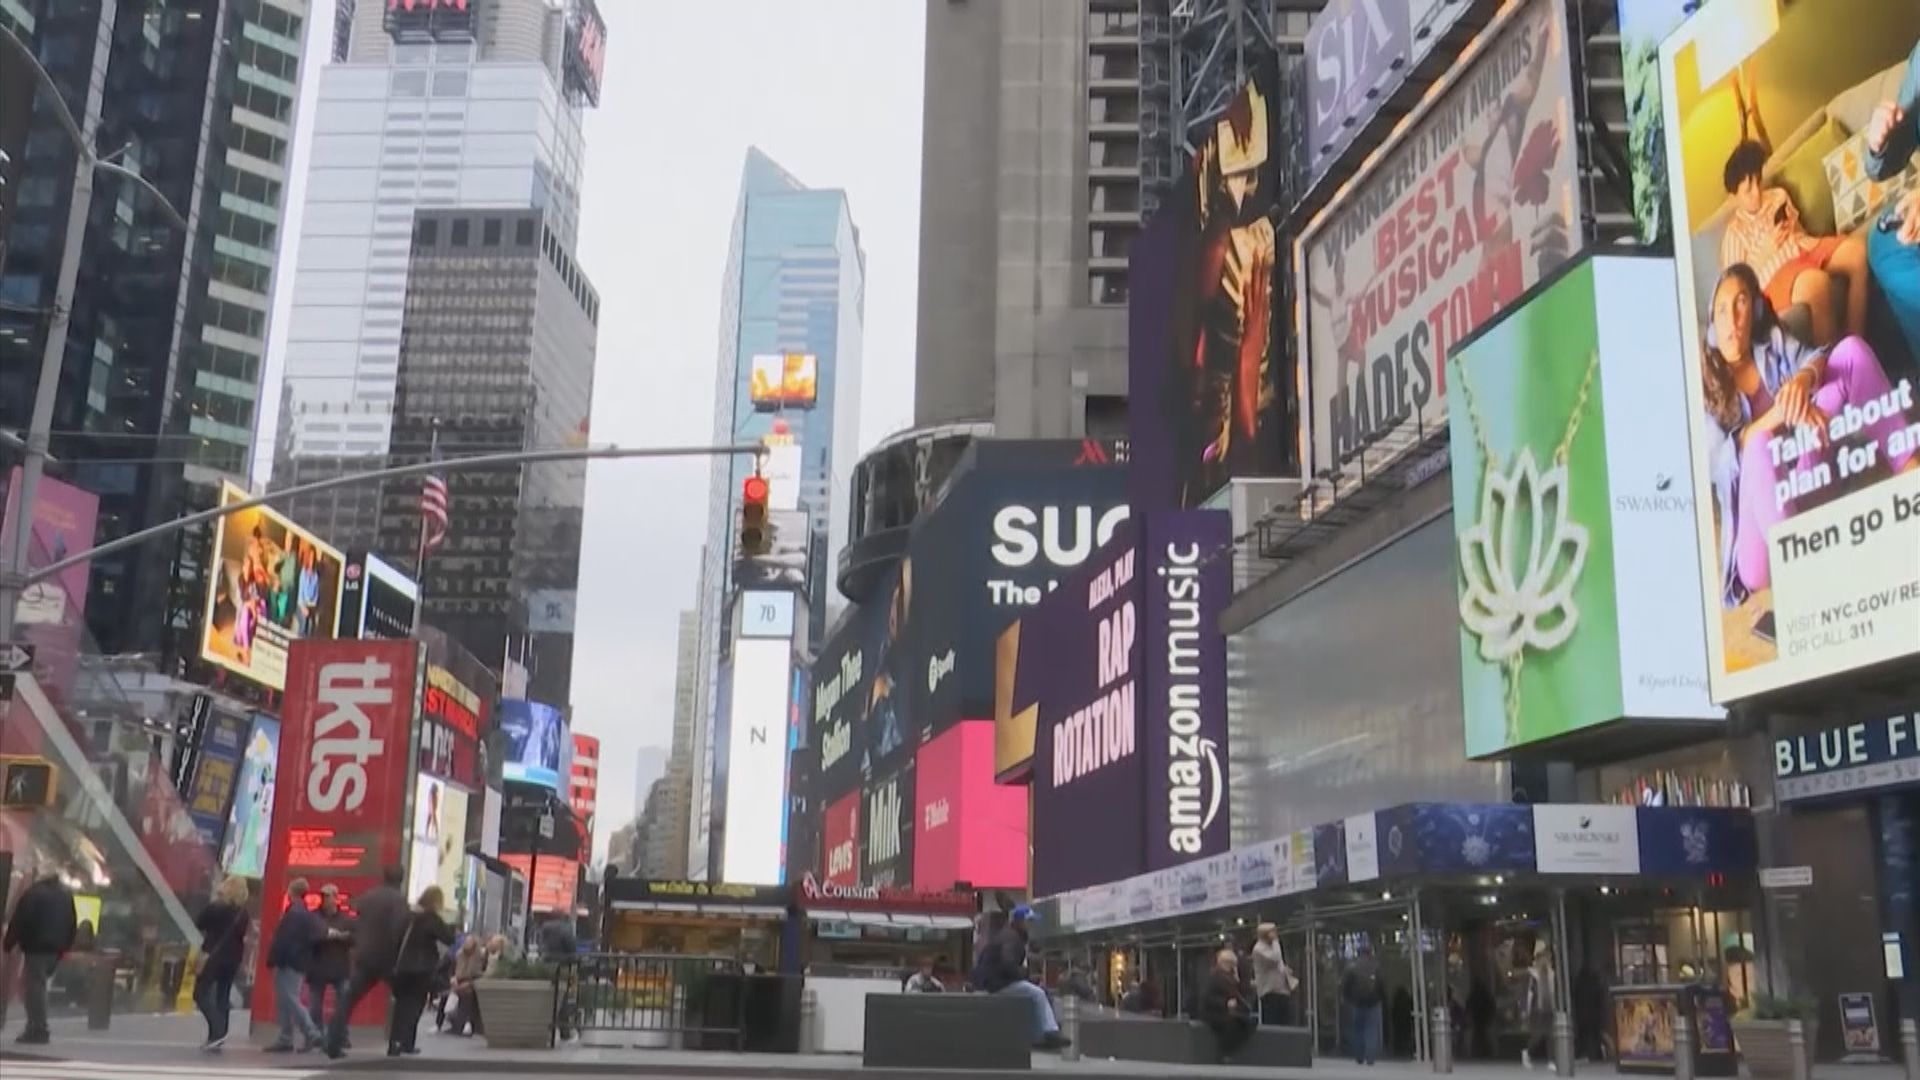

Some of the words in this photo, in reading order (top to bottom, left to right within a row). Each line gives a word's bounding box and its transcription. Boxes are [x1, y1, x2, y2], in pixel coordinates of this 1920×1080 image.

[1431, 96, 1465, 160] TONY
[1376, 151, 1460, 273] BEST
[1349, 192, 1497, 362] MUSICAL
[1768, 421, 1822, 467] Talk
[1829, 378, 1913, 441] about
[1775, 462, 1832, 512] plan
[1837, 441, 1879, 479] for
[1778, 524, 1840, 563] Then
[1850, 508, 1883, 546] go
[758, 603, 777, 623] 70
[987, 580, 1042, 605] The
[1157, 541, 1201, 675] music
[1098, 600, 1136, 688] RAP
[1788, 638, 1808, 656] OR
[1811, 629, 1845, 652] CALL
[1849, 618, 1874, 640] 311
[307, 655, 393, 813] tkts
[1053, 679, 1136, 788] ROTATION
[1168, 683, 1203, 853] amazon
[1775, 722, 1869, 776] BLUE
